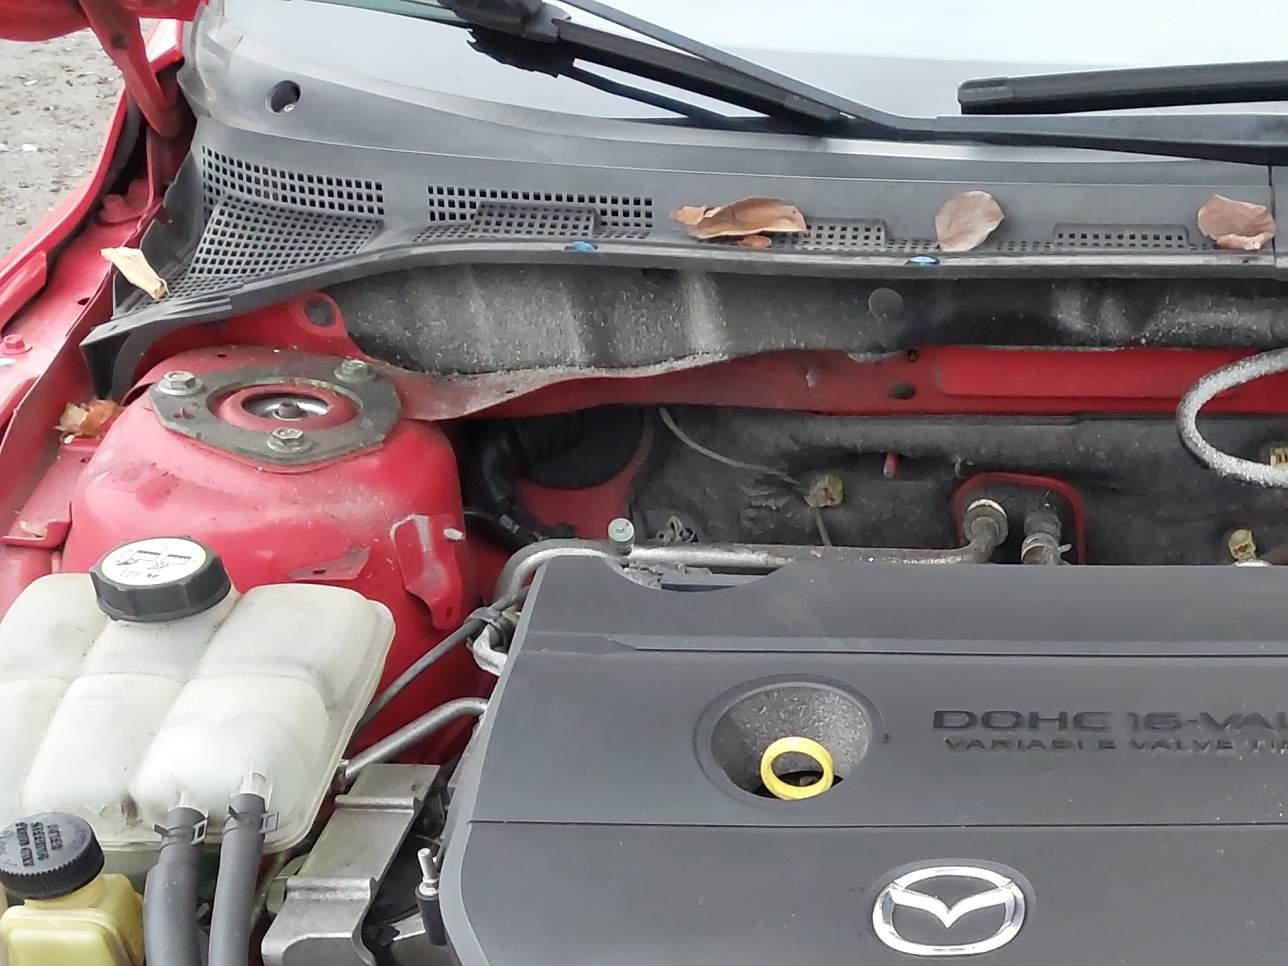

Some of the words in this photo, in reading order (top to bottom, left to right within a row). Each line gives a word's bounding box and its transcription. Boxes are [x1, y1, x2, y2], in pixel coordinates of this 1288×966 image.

[933, 710, 1112, 729] DOHC
[944, 738, 1116, 750] VARIABLE
[1128, 738, 1234, 751] VALVE
